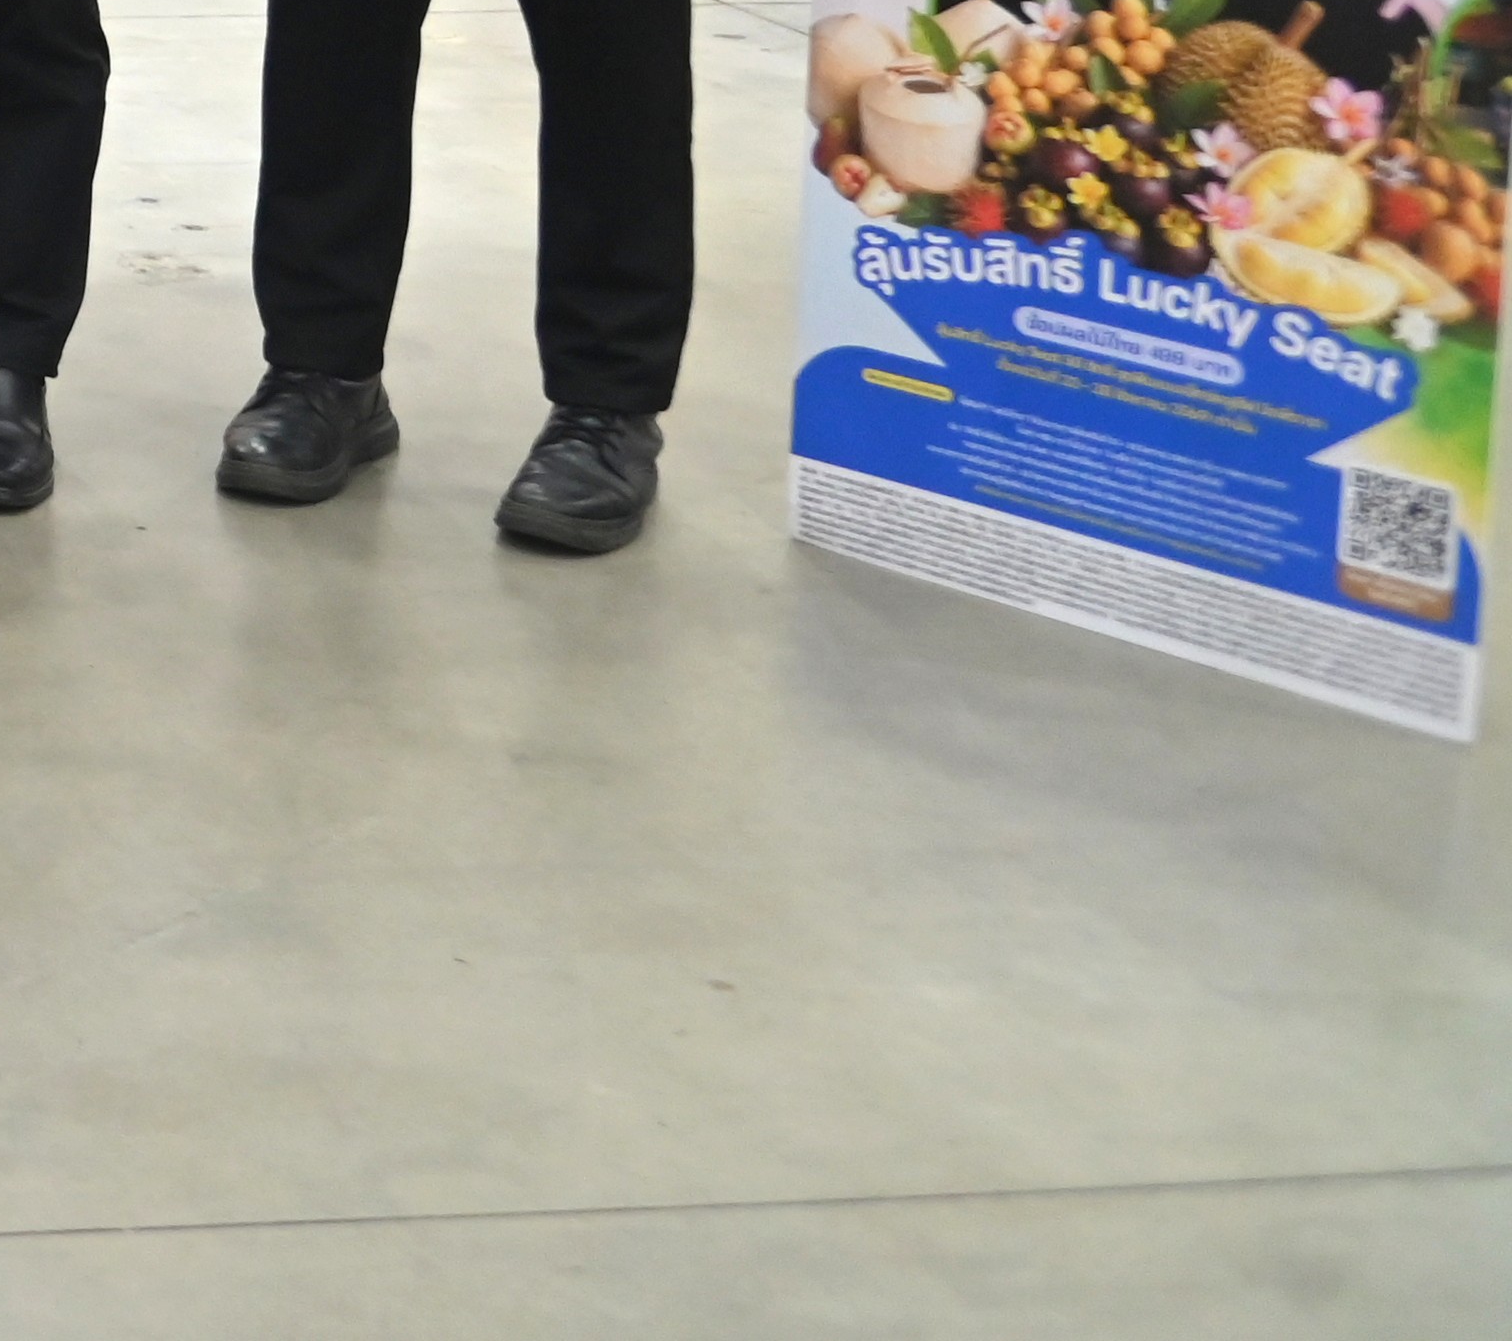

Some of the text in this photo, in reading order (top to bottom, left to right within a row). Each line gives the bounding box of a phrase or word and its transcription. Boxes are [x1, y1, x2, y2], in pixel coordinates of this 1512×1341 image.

[859, 232, 1087, 296] ลุ้นรับสิทธิ์
[1098, 258, 1259, 348] Lucky
[1271, 310, 1403, 402] Seat
